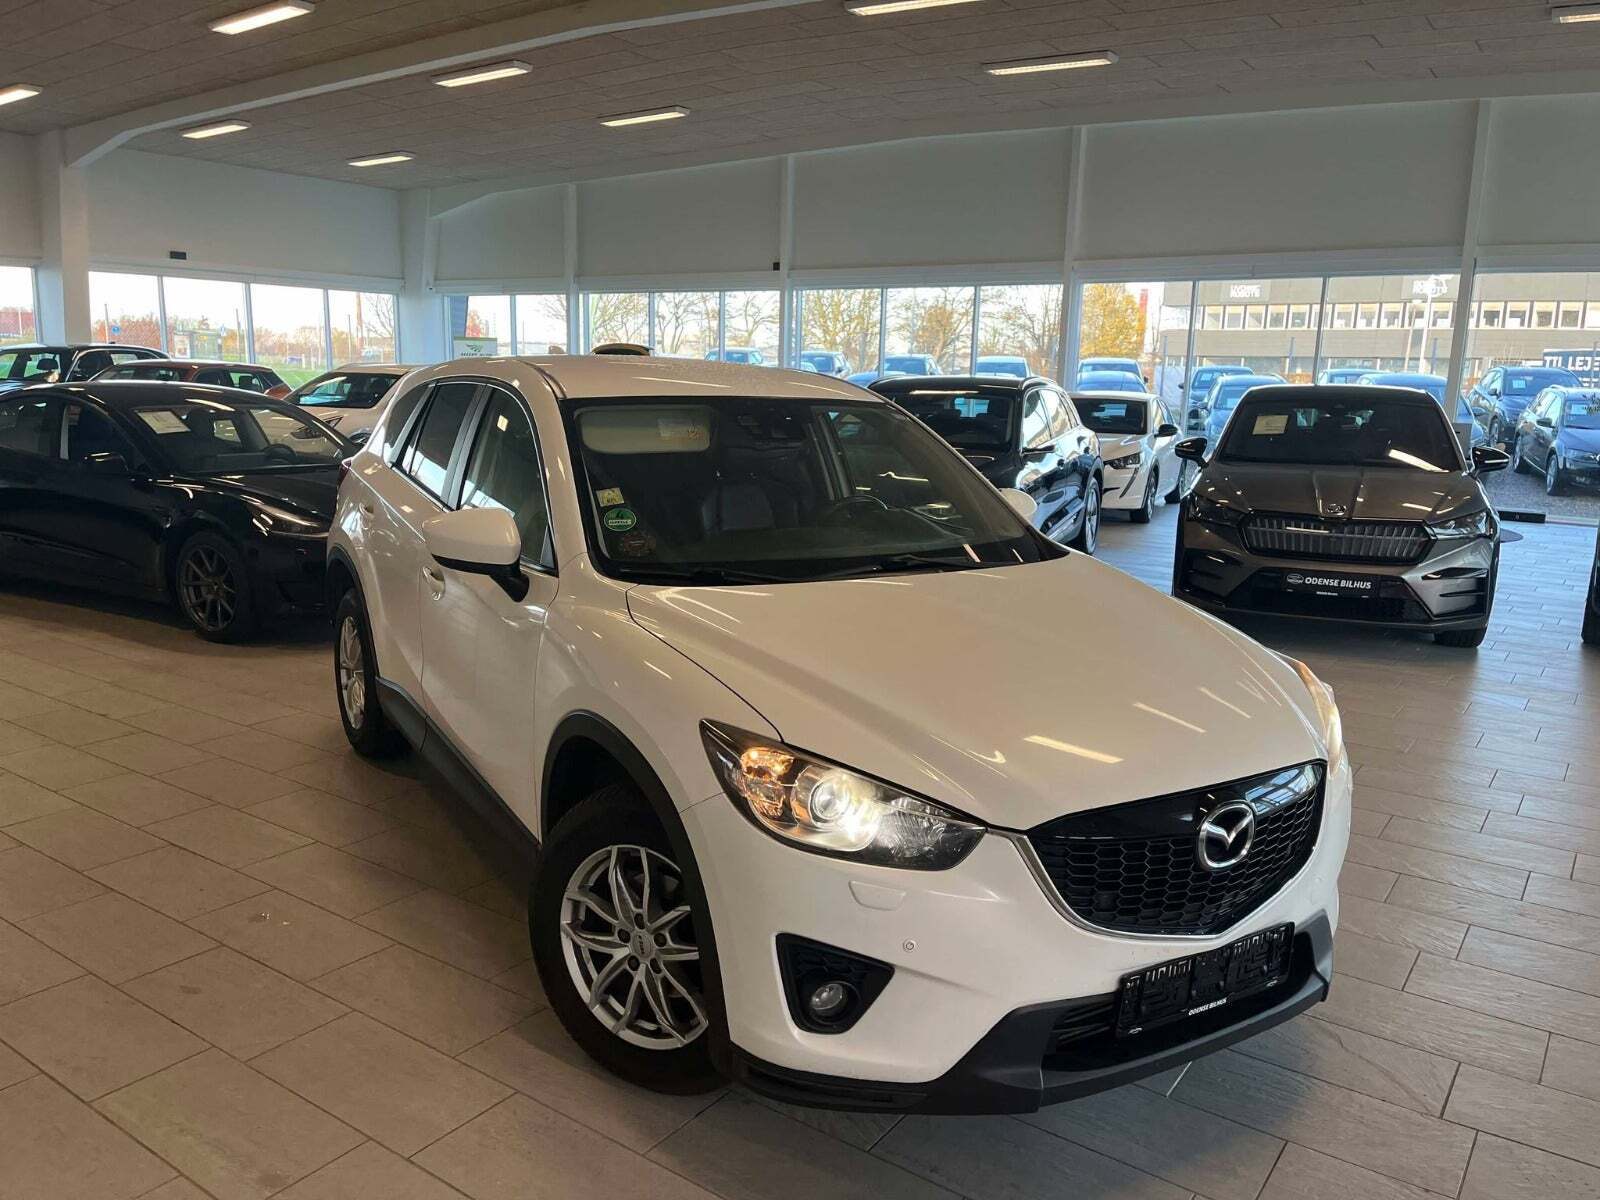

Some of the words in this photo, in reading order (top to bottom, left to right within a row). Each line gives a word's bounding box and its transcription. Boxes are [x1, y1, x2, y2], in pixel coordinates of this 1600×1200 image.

[1304, 576, 1339, 587] ODENSE
[1339, 579, 1372, 590] BILHUS
[1188, 1003, 1209, 1016] ODENSE
[1208, 997, 1228, 1009] BILHUS
